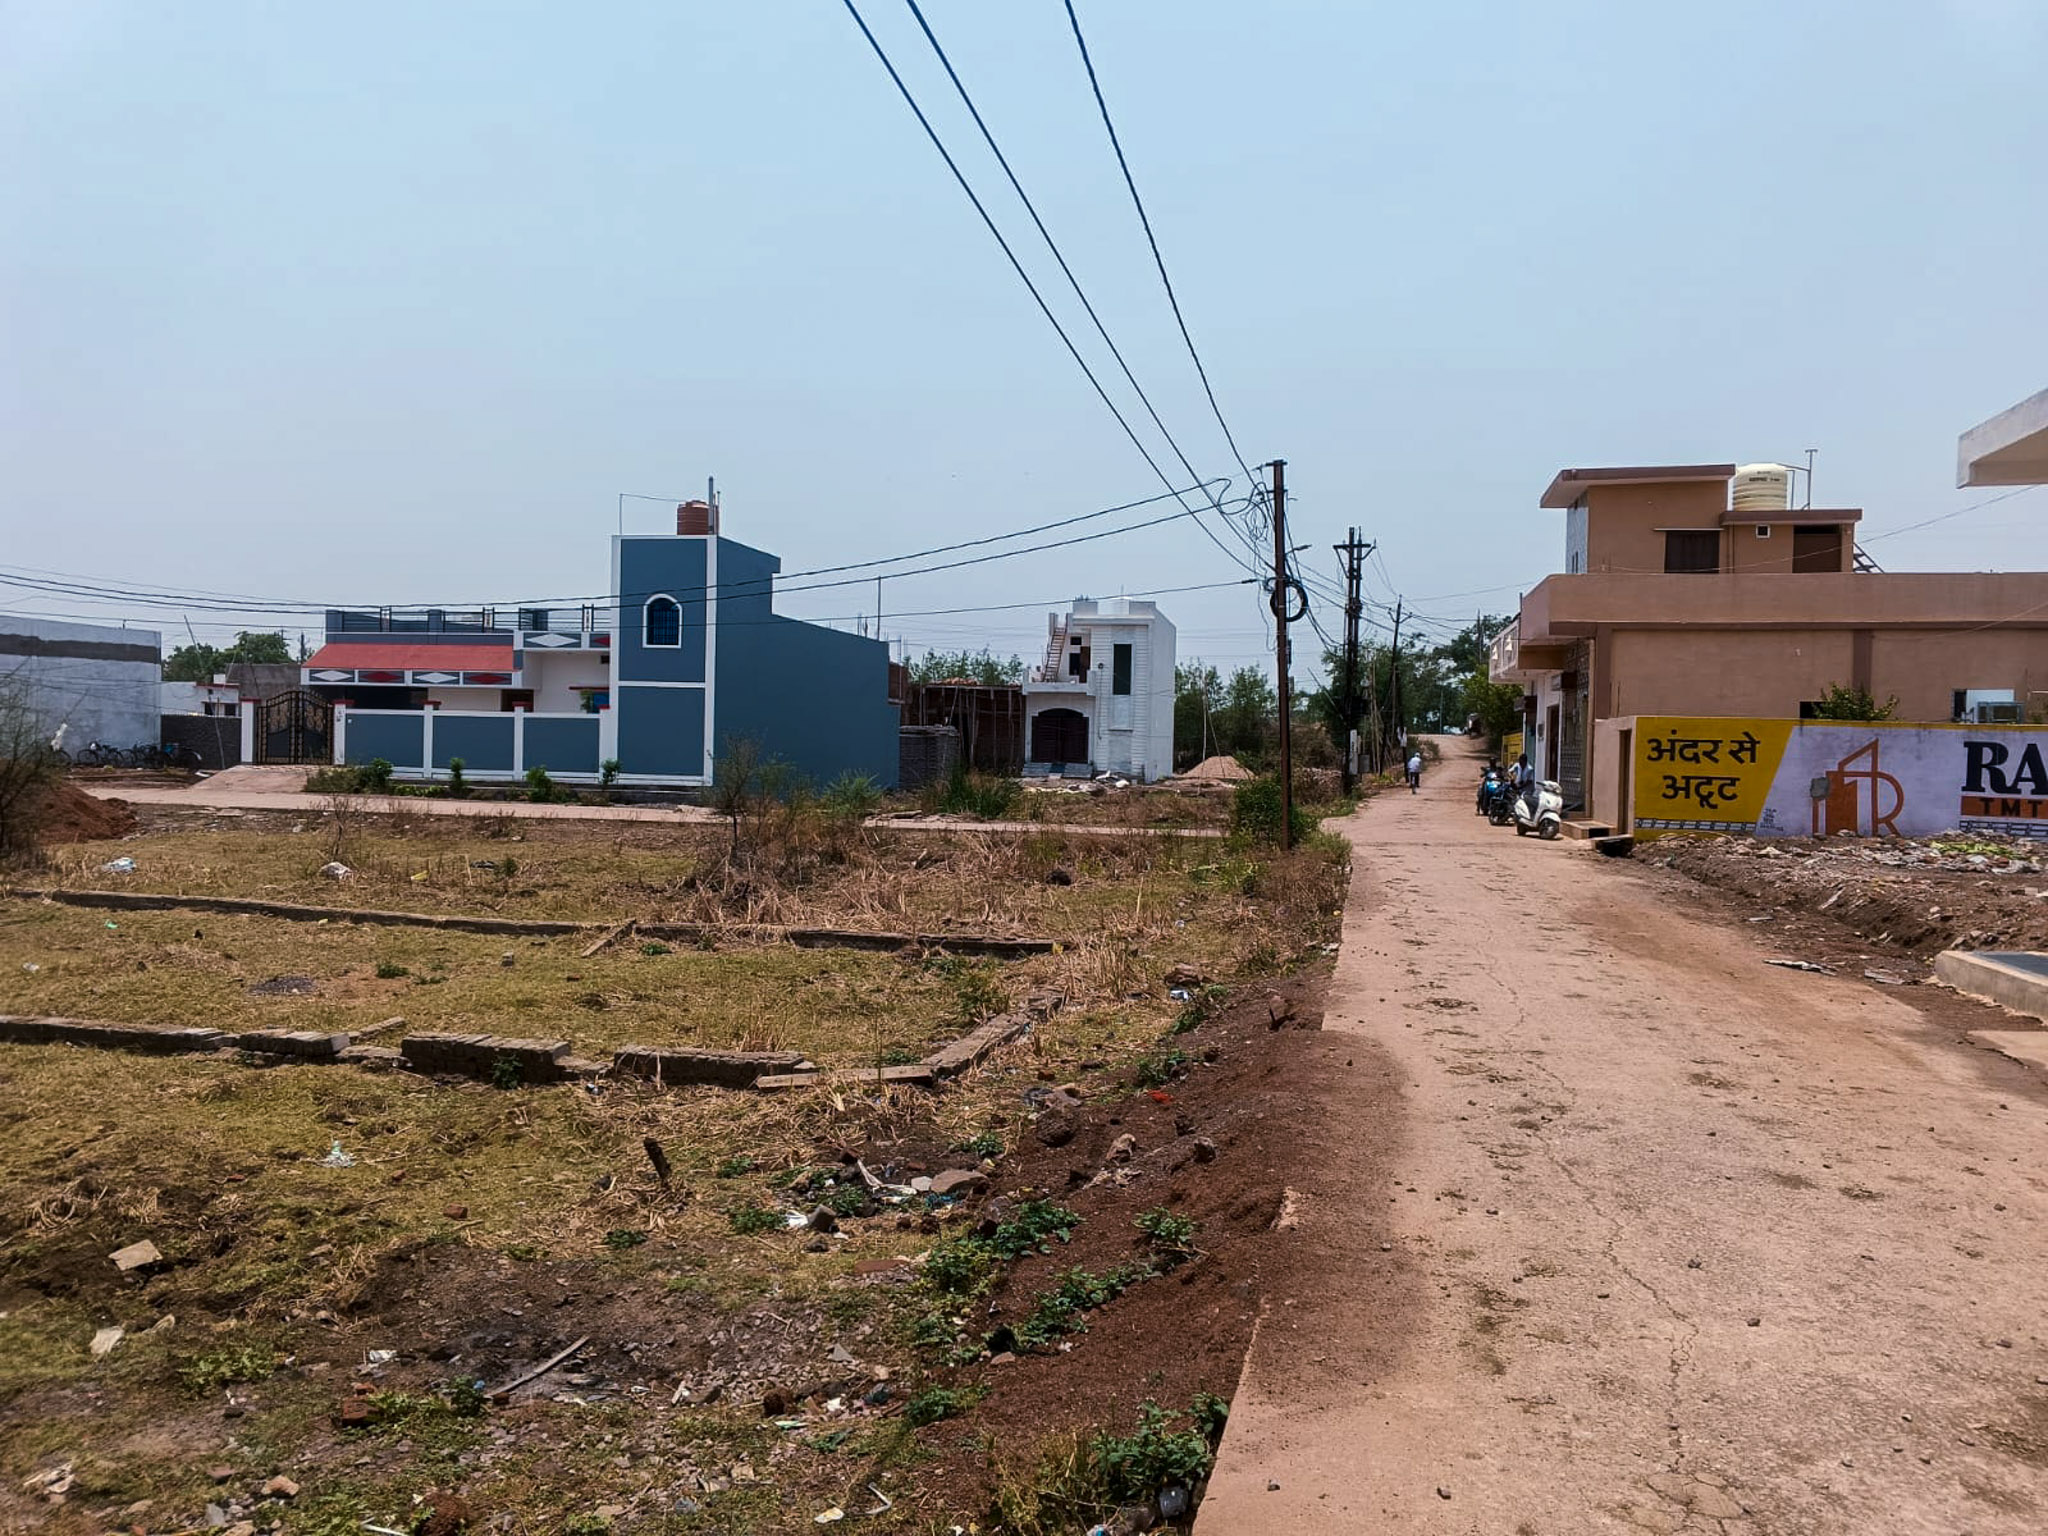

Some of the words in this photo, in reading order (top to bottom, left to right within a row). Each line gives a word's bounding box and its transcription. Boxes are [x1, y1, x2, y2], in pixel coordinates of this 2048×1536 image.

[1646, 729, 1723, 764] अंदर
[1728, 731, 1761, 764] से
[1662, 775, 1740, 809] अटूट
[1978, 797, 2043, 818] TMT
